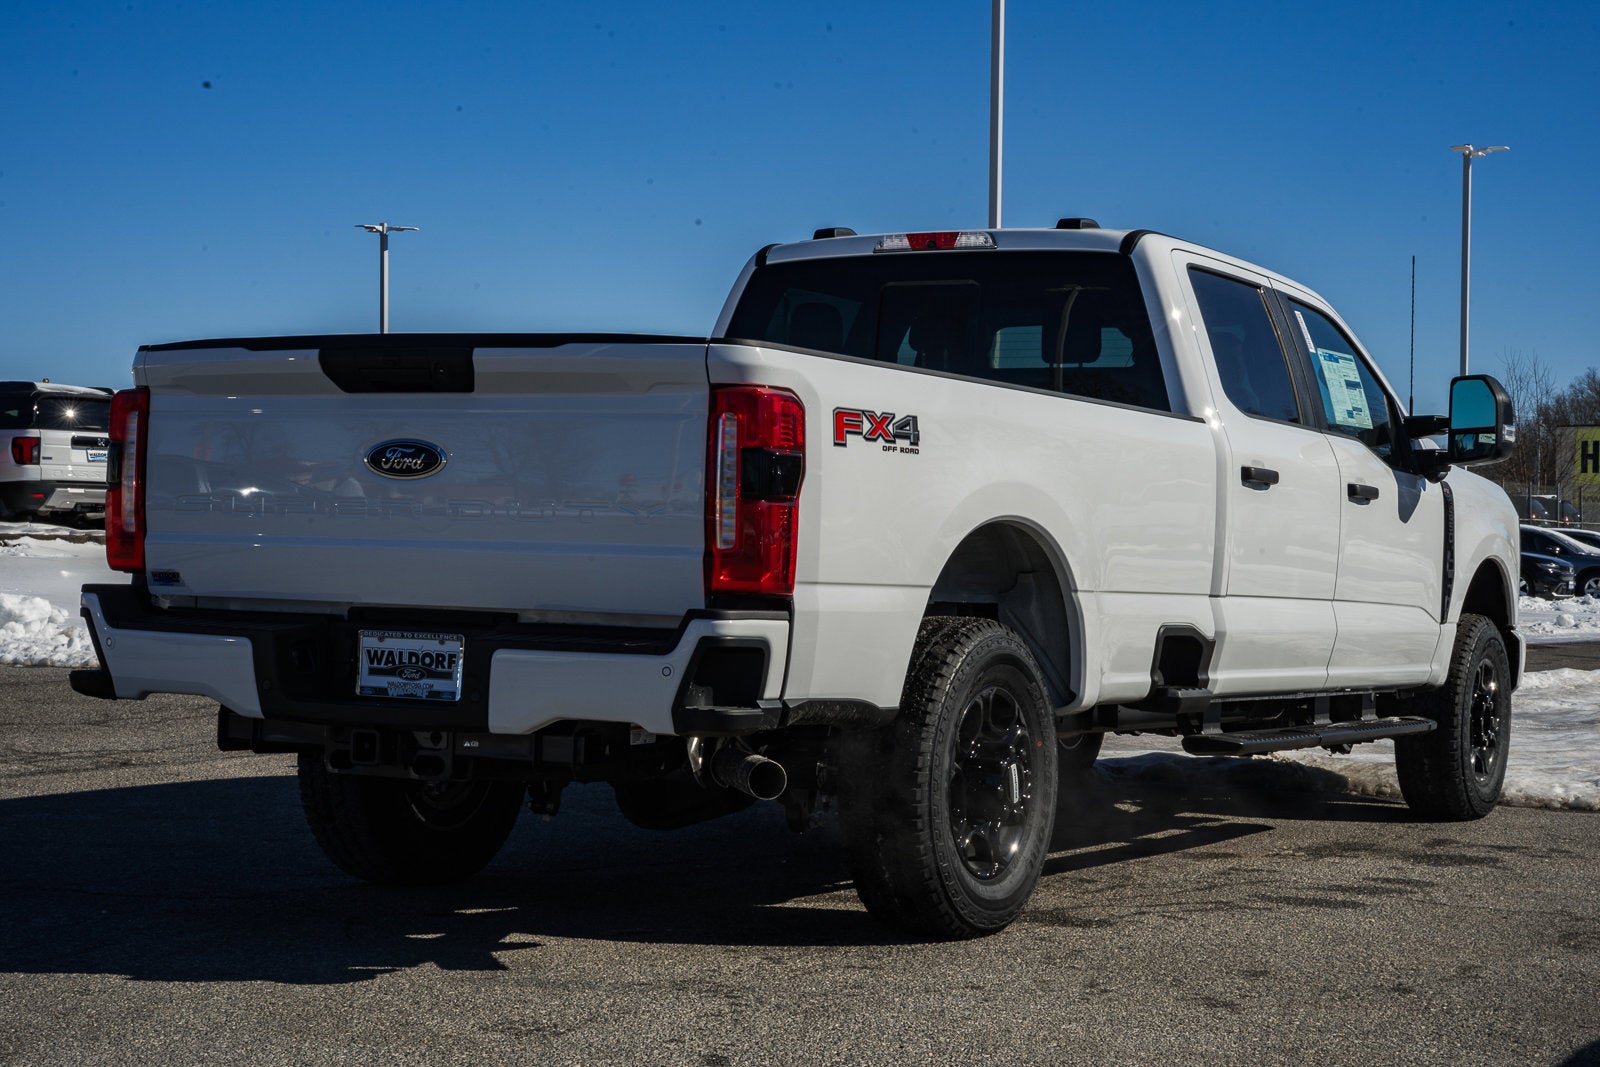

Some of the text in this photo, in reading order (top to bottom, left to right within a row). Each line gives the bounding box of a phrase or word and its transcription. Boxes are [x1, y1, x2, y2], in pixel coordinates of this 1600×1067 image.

[832, 406, 920, 448] FX4
[381, 446, 426, 470] Ford
[882, 445, 920, 455] OFF ROAD
[414, 633, 458, 641] EXCELLENCE
[365, 648, 458, 671] WALDORF
[402, 668, 422, 680] Ford
